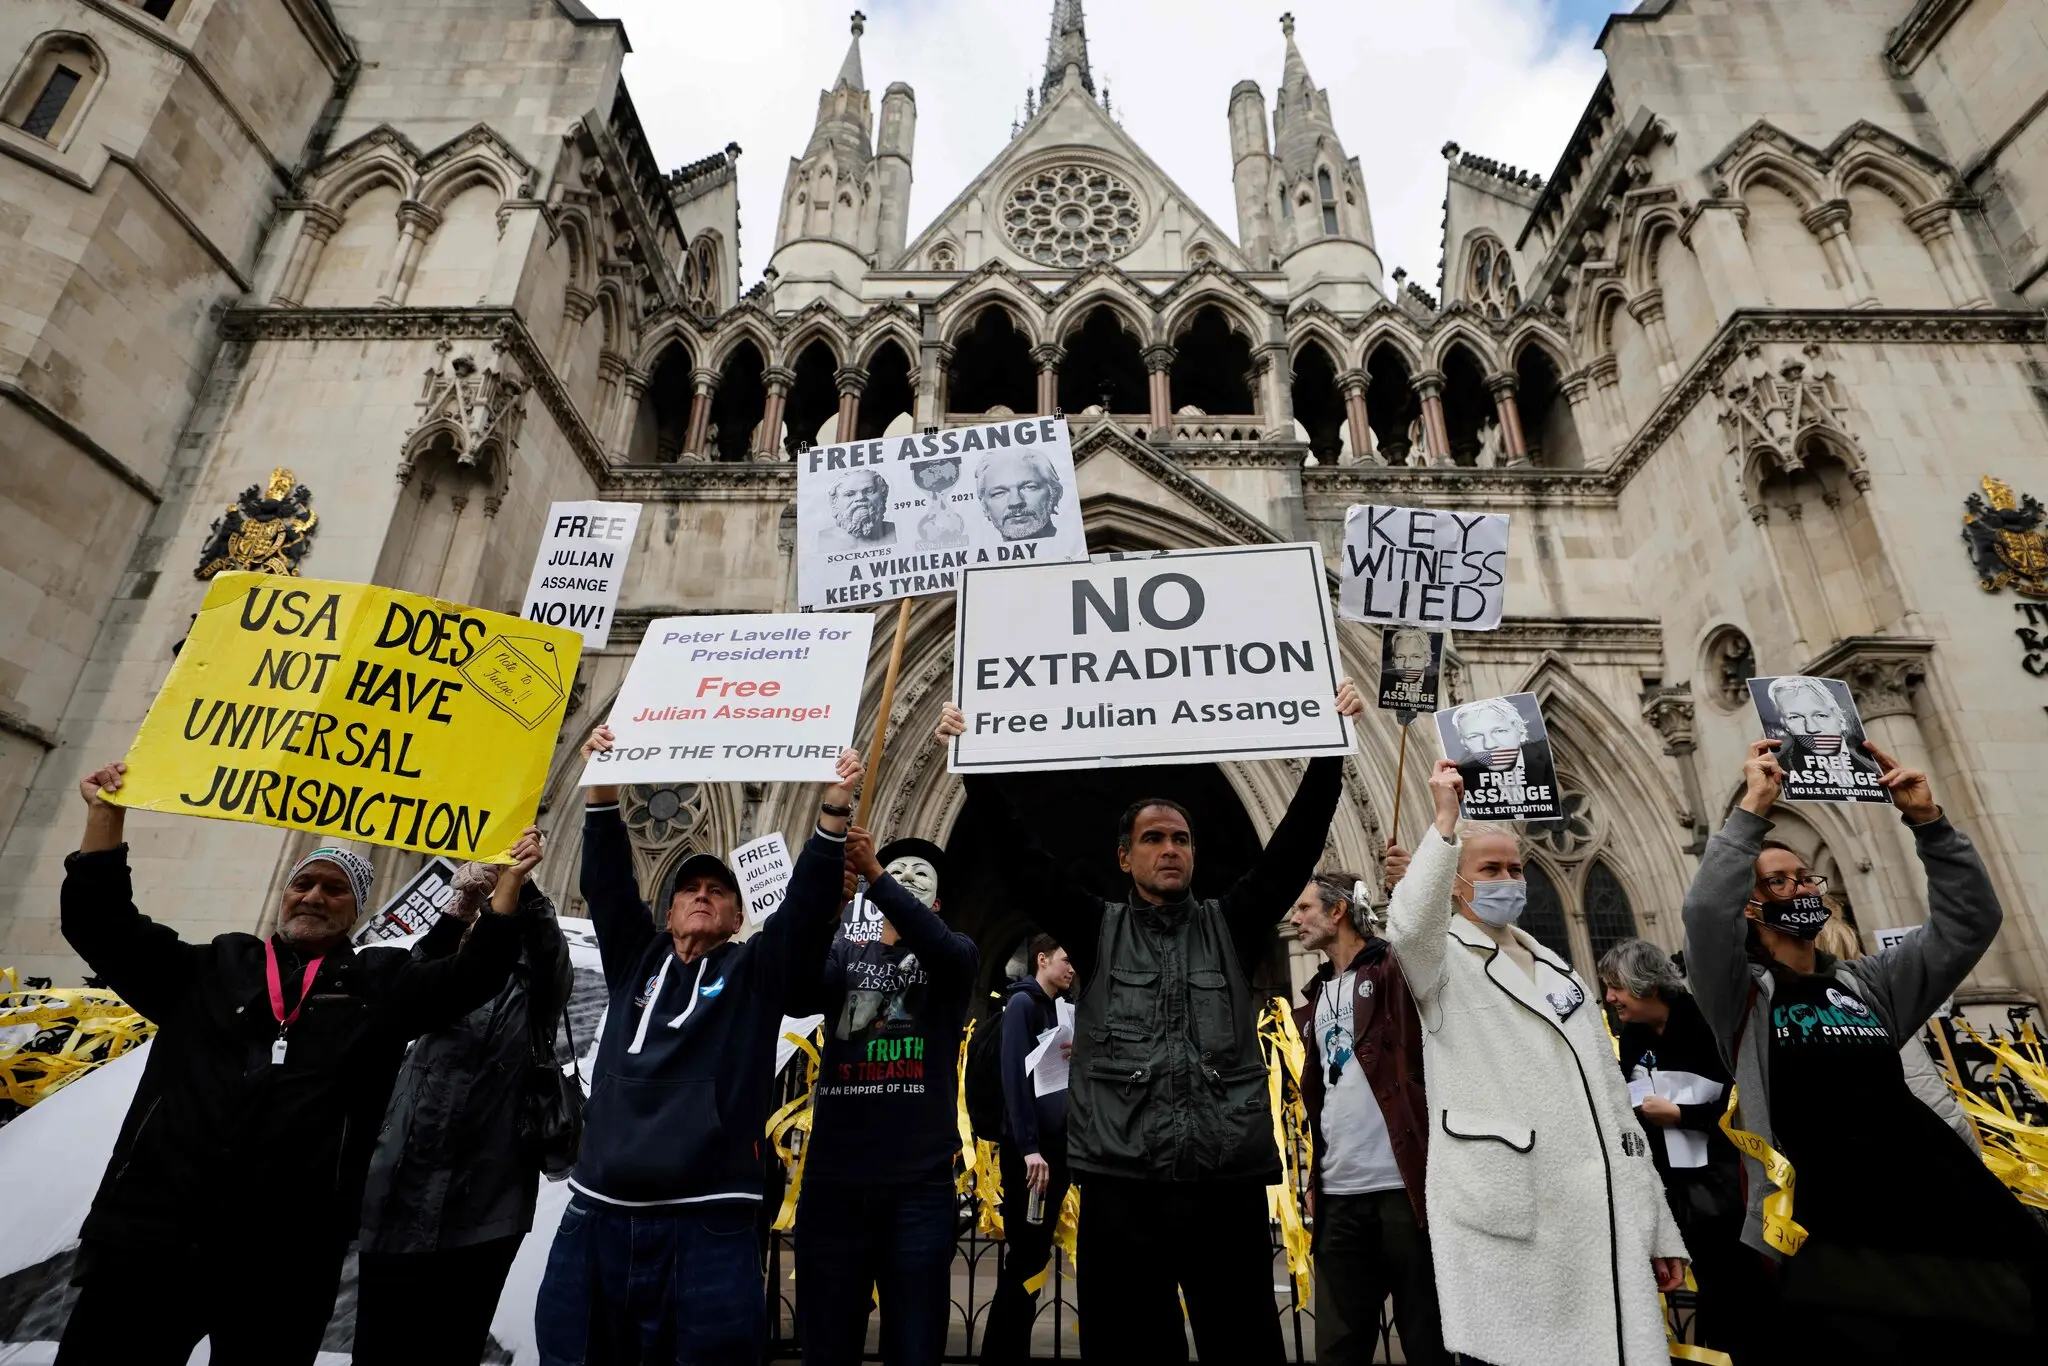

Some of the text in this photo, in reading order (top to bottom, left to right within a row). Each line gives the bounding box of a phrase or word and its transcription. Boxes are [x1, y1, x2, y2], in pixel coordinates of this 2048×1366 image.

[809, 420, 1057, 473] FREE ASSANGE
[894, 498, 927, 511] 399 BC
[951, 493, 974, 503] 2021
[554, 515, 627, 540] FREE
[1368, 506, 1485, 553] KEY
[548, 550, 614, 568] JULIAN
[827, 548, 892, 563] SOCRATES
[849, 542, 1038, 581] A WIKILEAK A DAY
[1347, 544, 1506, 587] WITNESS
[541, 577, 608, 592] ASSANGE
[826, 571, 958, 605] KEEPS TYRAN
[1071, 573, 1206, 635] NO
[1363, 578, 1486, 622] LIED
[529, 602, 605, 630] NOW!
[240, 587, 487, 667] USA DOES
[662, 627, 852, 645] Peter Lavelle for
[691, 647, 810, 662] President!
[495, 652, 532, 685] Note to
[976, 640, 1314, 691] EXTRADITION
[248, 648, 463, 724] NOT HAVE
[696, 677, 781, 698] Free
[1382, 690, 1435, 703] ASSANGE
[1395, 682, 1423, 693] FREE
[632, 705, 831, 723] Julian Assange!
[975, 699, 1320, 735] Free Julian Assange
[183, 698, 422, 778] UNIVERSAL
[597, 745, 844, 763] STOP THE TORTURE!
[1803, 755, 1854, 770] FREE
[1479, 771, 1527, 787] FREE
[1789, 770, 1880, 787] ASSANGE
[1463, 786, 1552, 804] ASSANGE
[1791, 787, 1884, 797] NO U.S. EXTRADITION
[180, 765, 491, 852] JURISDICTION
[1465, 804, 1553, 815] NO U.S. EXTRADITION
[738, 841, 780, 868] FREE
[746, 859, 783, 882] JULIAN
[417, 873, 454, 908] DO
[750, 872, 789, 894] ASSANGE
[406, 891, 441, 927] EXTRA
[752, 886, 787, 913] NOW
[1793, 898, 1820, 909] FREE
[393, 903, 430, 935] ASSA
[844, 921, 884, 934] YEARS
[1780, 911, 1829, 923] ASSAN
[386, 922, 408, 937] Jour
[844, 933, 882, 942] ENOUGH
[858, 971, 927, 992] ASSANGE
[1777, 1027, 1790, 1038] IS
[867, 1037, 924, 1062] TRUTH
[839, 1059, 924, 1080] IS TREASON
[820, 1083, 925, 1095] IN AN EMPIRE OF LIES
